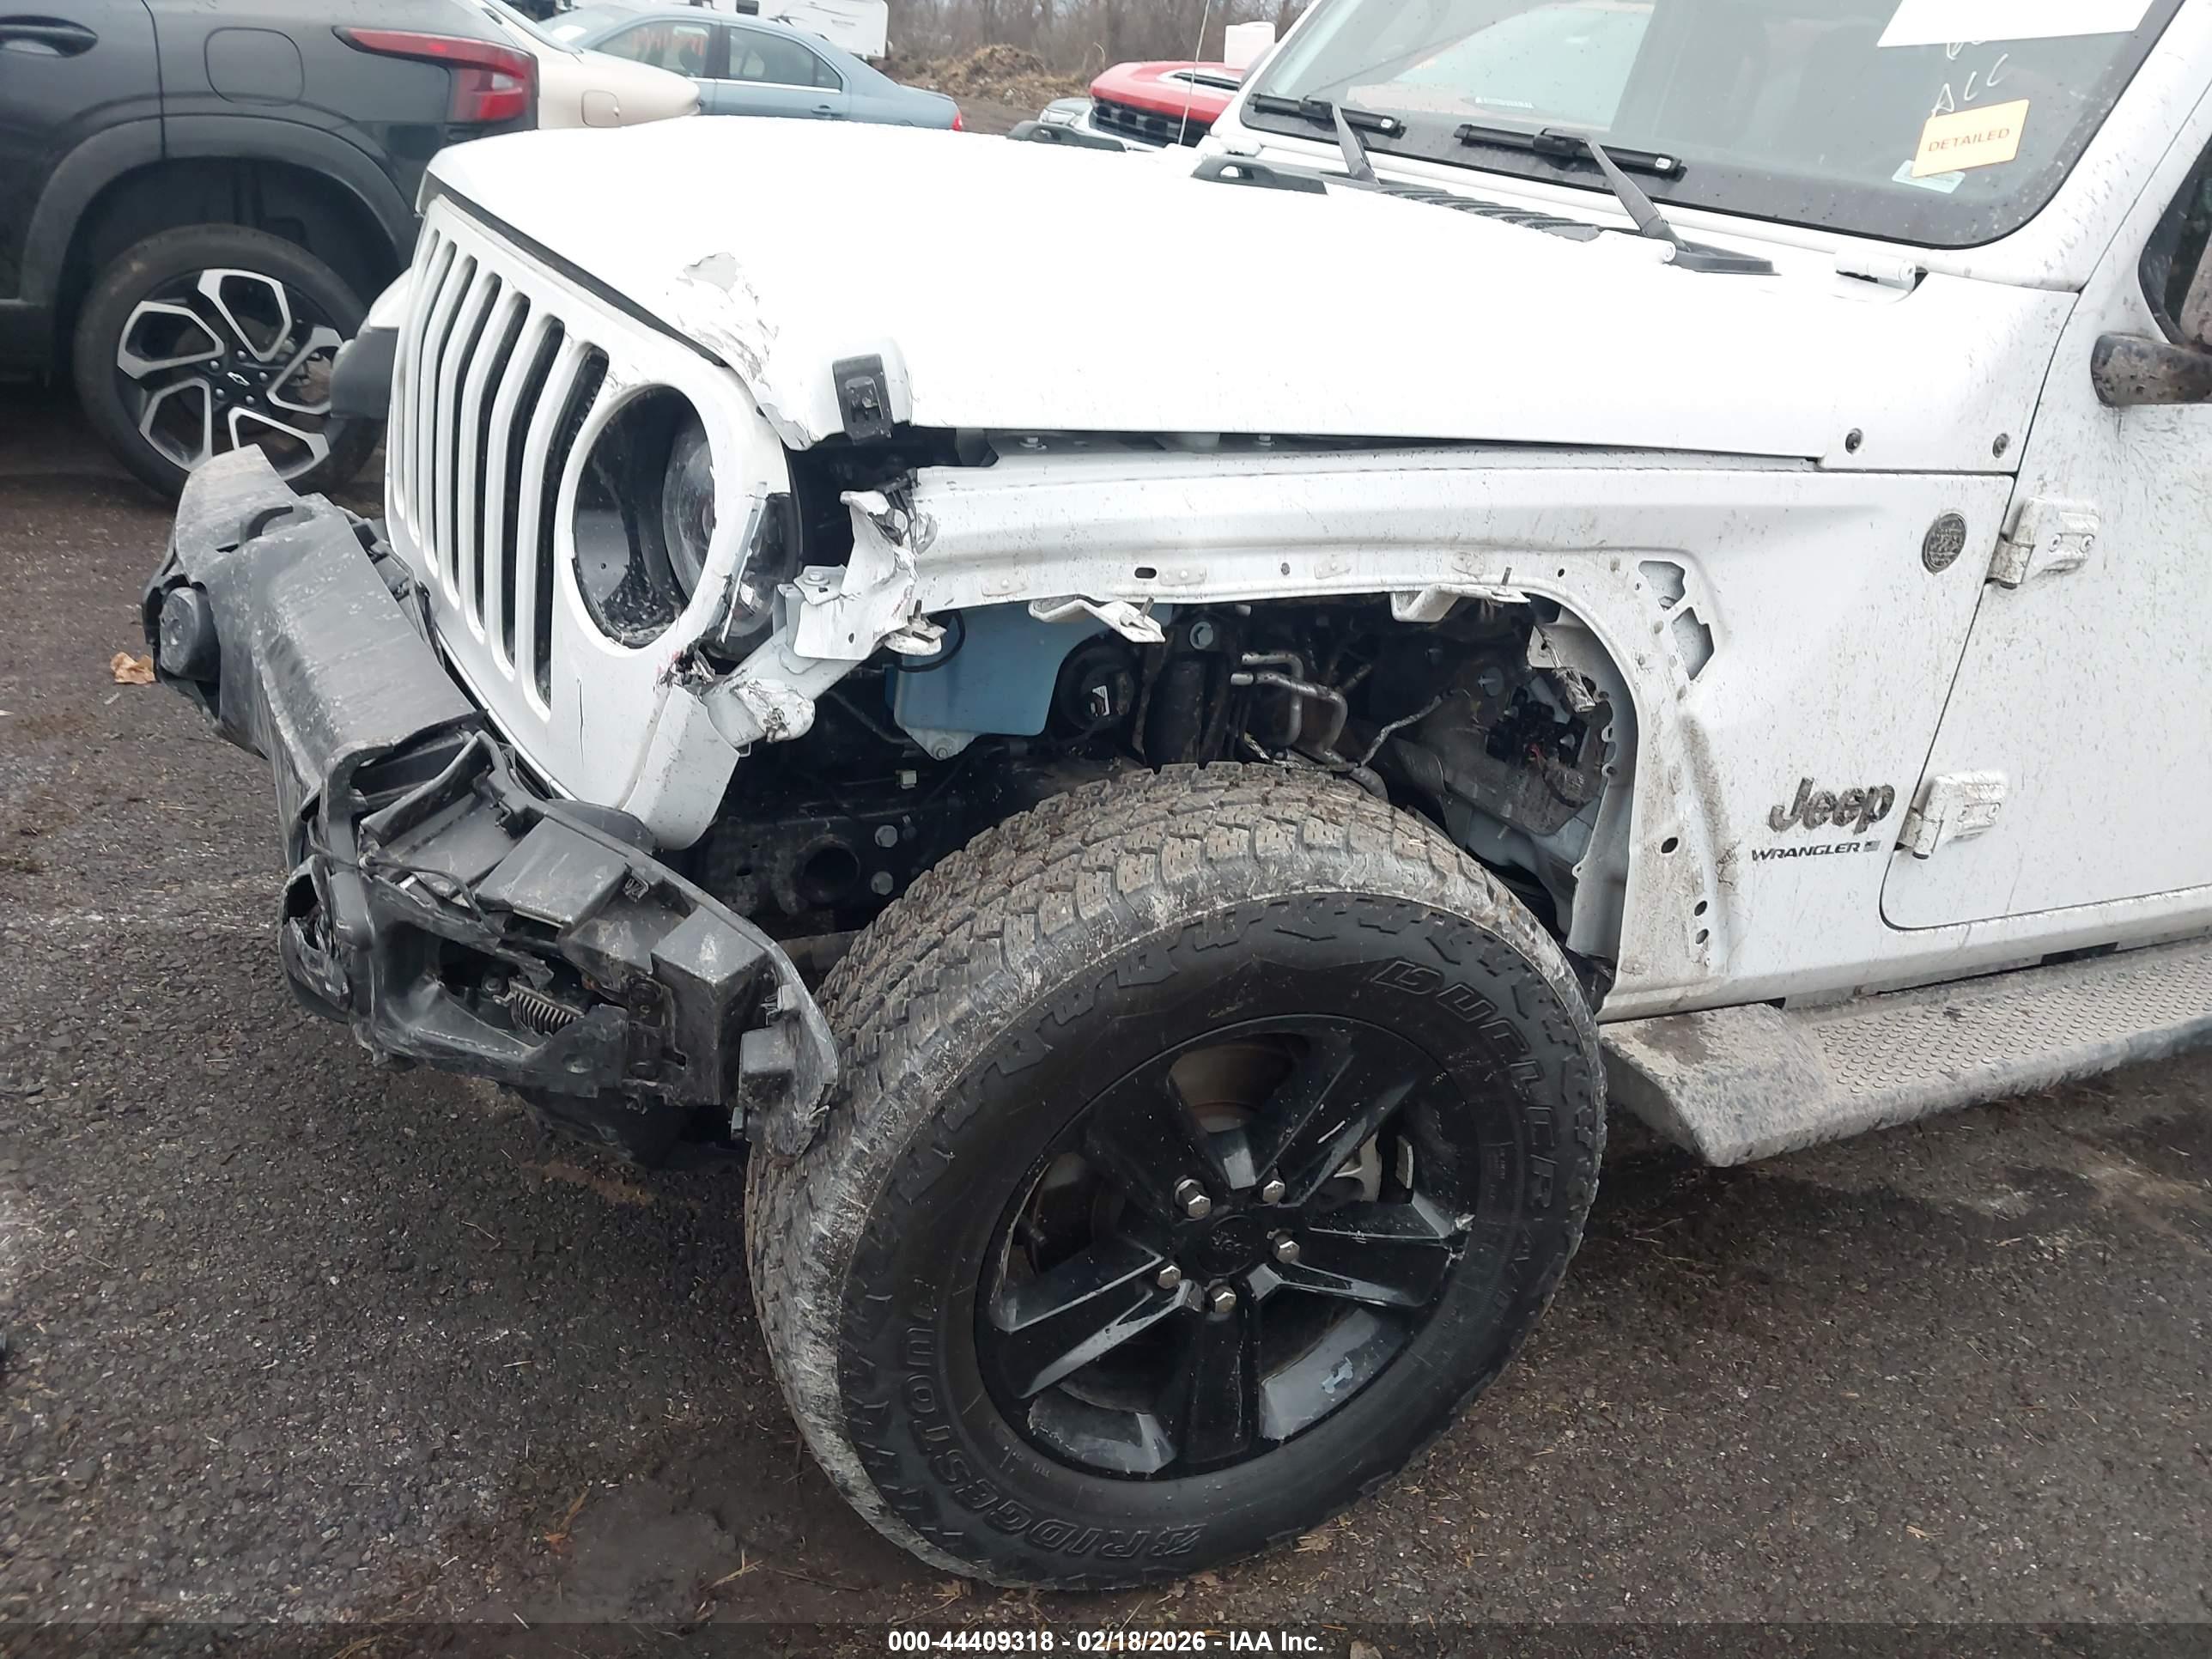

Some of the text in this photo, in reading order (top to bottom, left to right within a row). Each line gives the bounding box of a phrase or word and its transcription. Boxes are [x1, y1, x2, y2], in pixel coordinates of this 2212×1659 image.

[1928, 128, 2010, 152] DETAILED
[1767, 777, 1896, 835] Jeep
[1751, 842, 1861, 862] WRANGLER
[903, 1293, 1207, 1559] BRIDGESTONE
